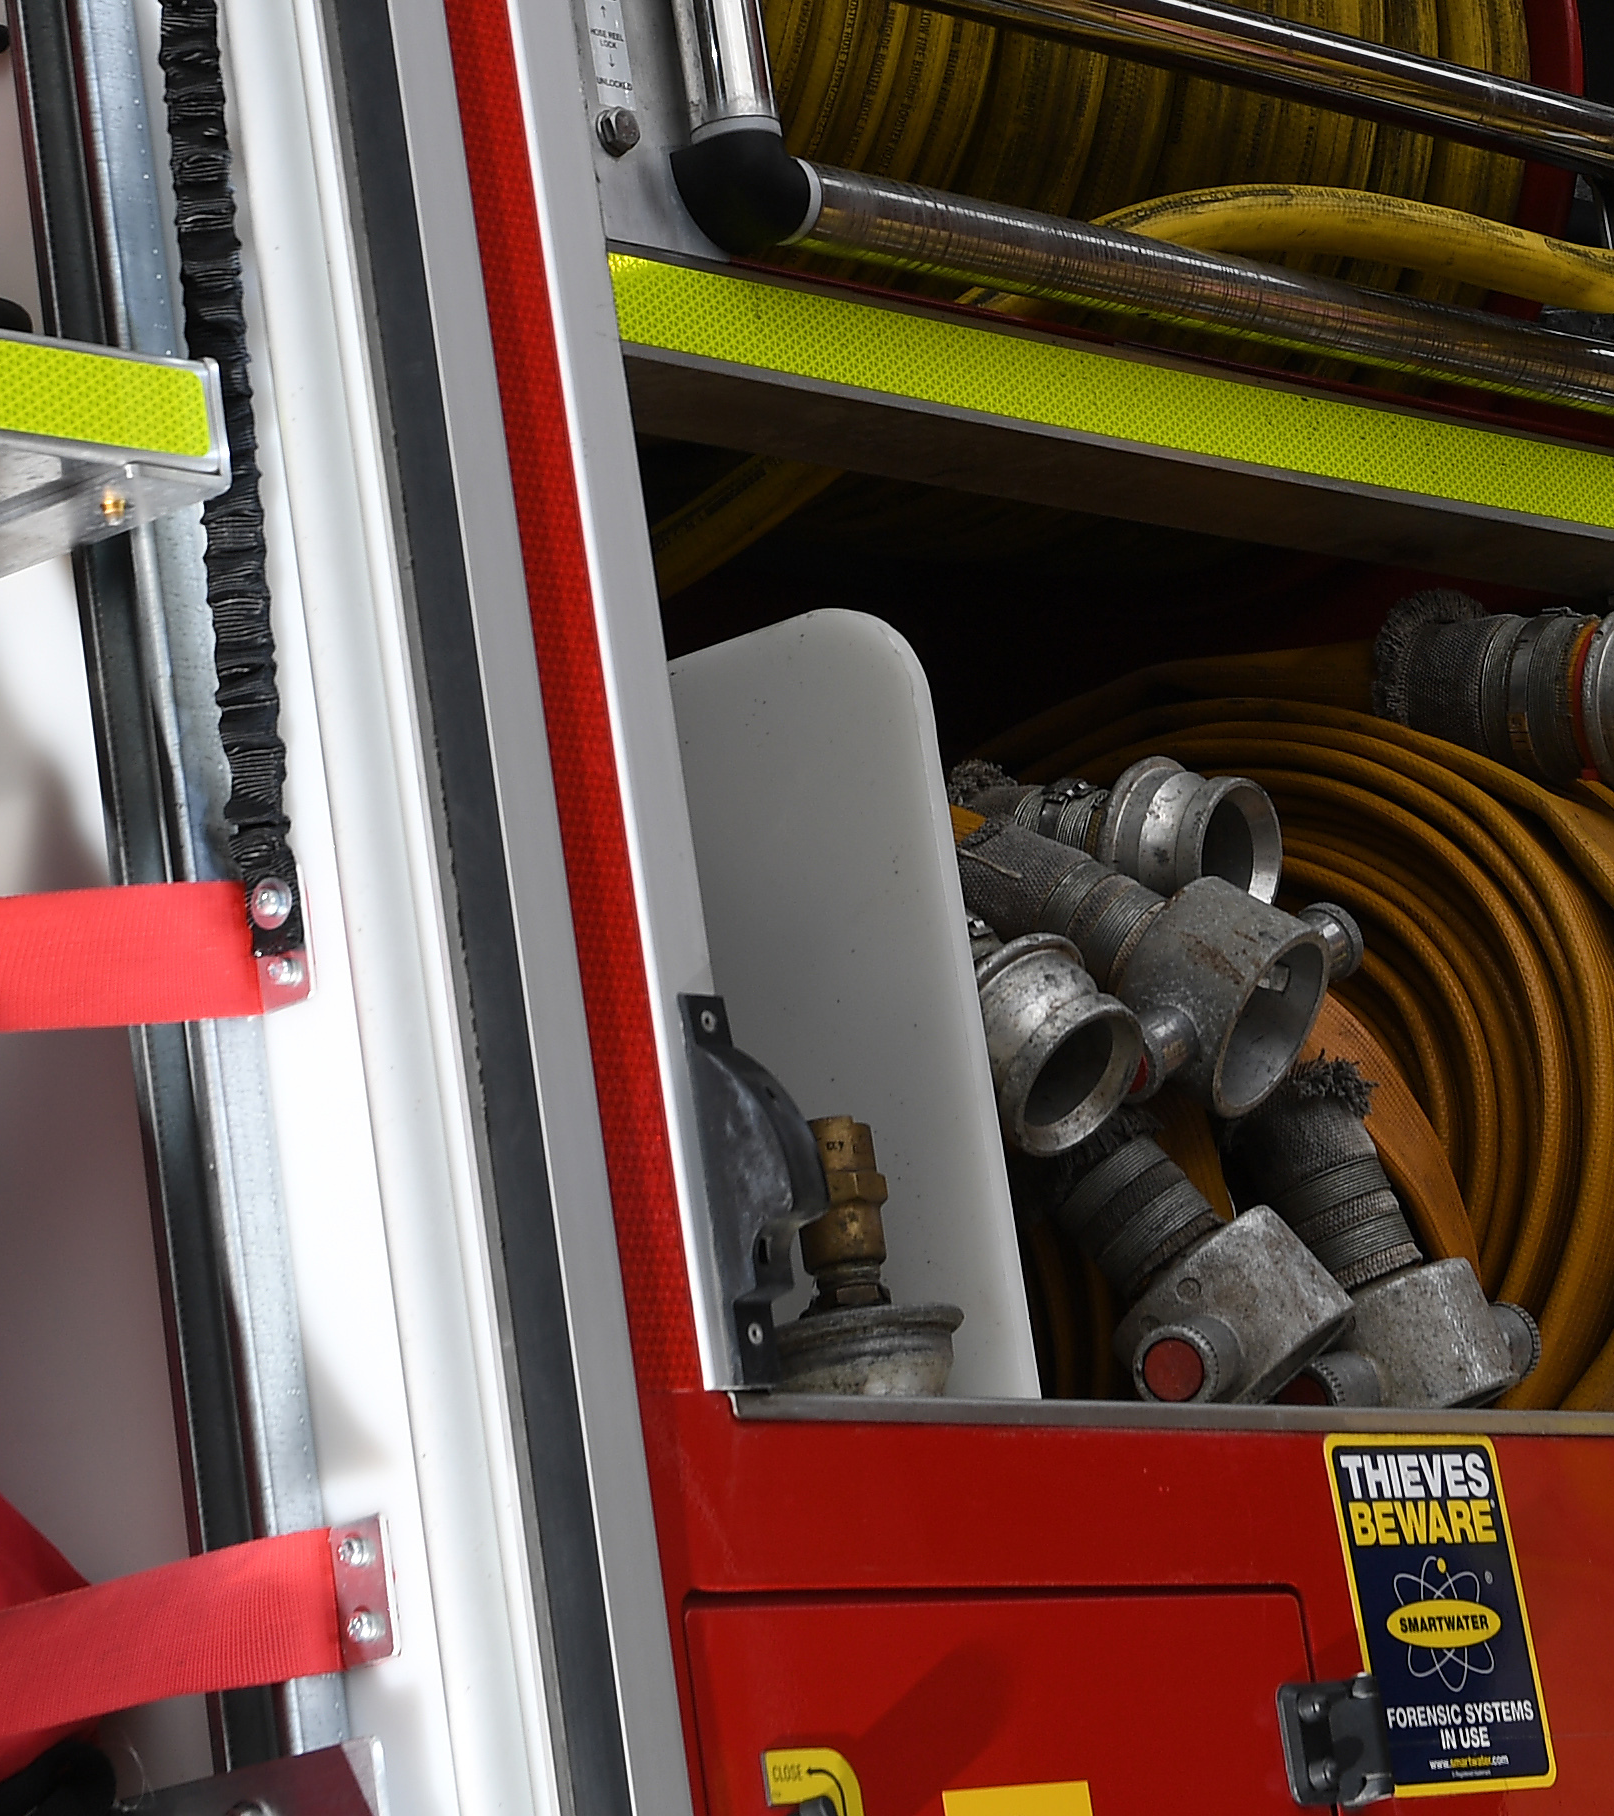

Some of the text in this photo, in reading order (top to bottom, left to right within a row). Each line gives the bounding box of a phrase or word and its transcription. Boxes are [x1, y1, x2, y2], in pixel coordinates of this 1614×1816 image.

[600, 39, 617, 49] LOCK
[607, 30, 624, 42] REEL
[596, 77, 633, 91] UNLOCKED
[1340, 1453, 1490, 1499] THIEVES
[1349, 1500, 1497, 1545] BEWARE
[1399, 1614, 1489, 1634] SMARTWATER
[1386, 1699, 1534, 1729] FORENSIC SYSTEMS
[1440, 1726, 1491, 1750] IN USE
[1429, 1754, 1510, 1771] www.smartwater.com
[772, 1764, 803, 1782] CLOSE
